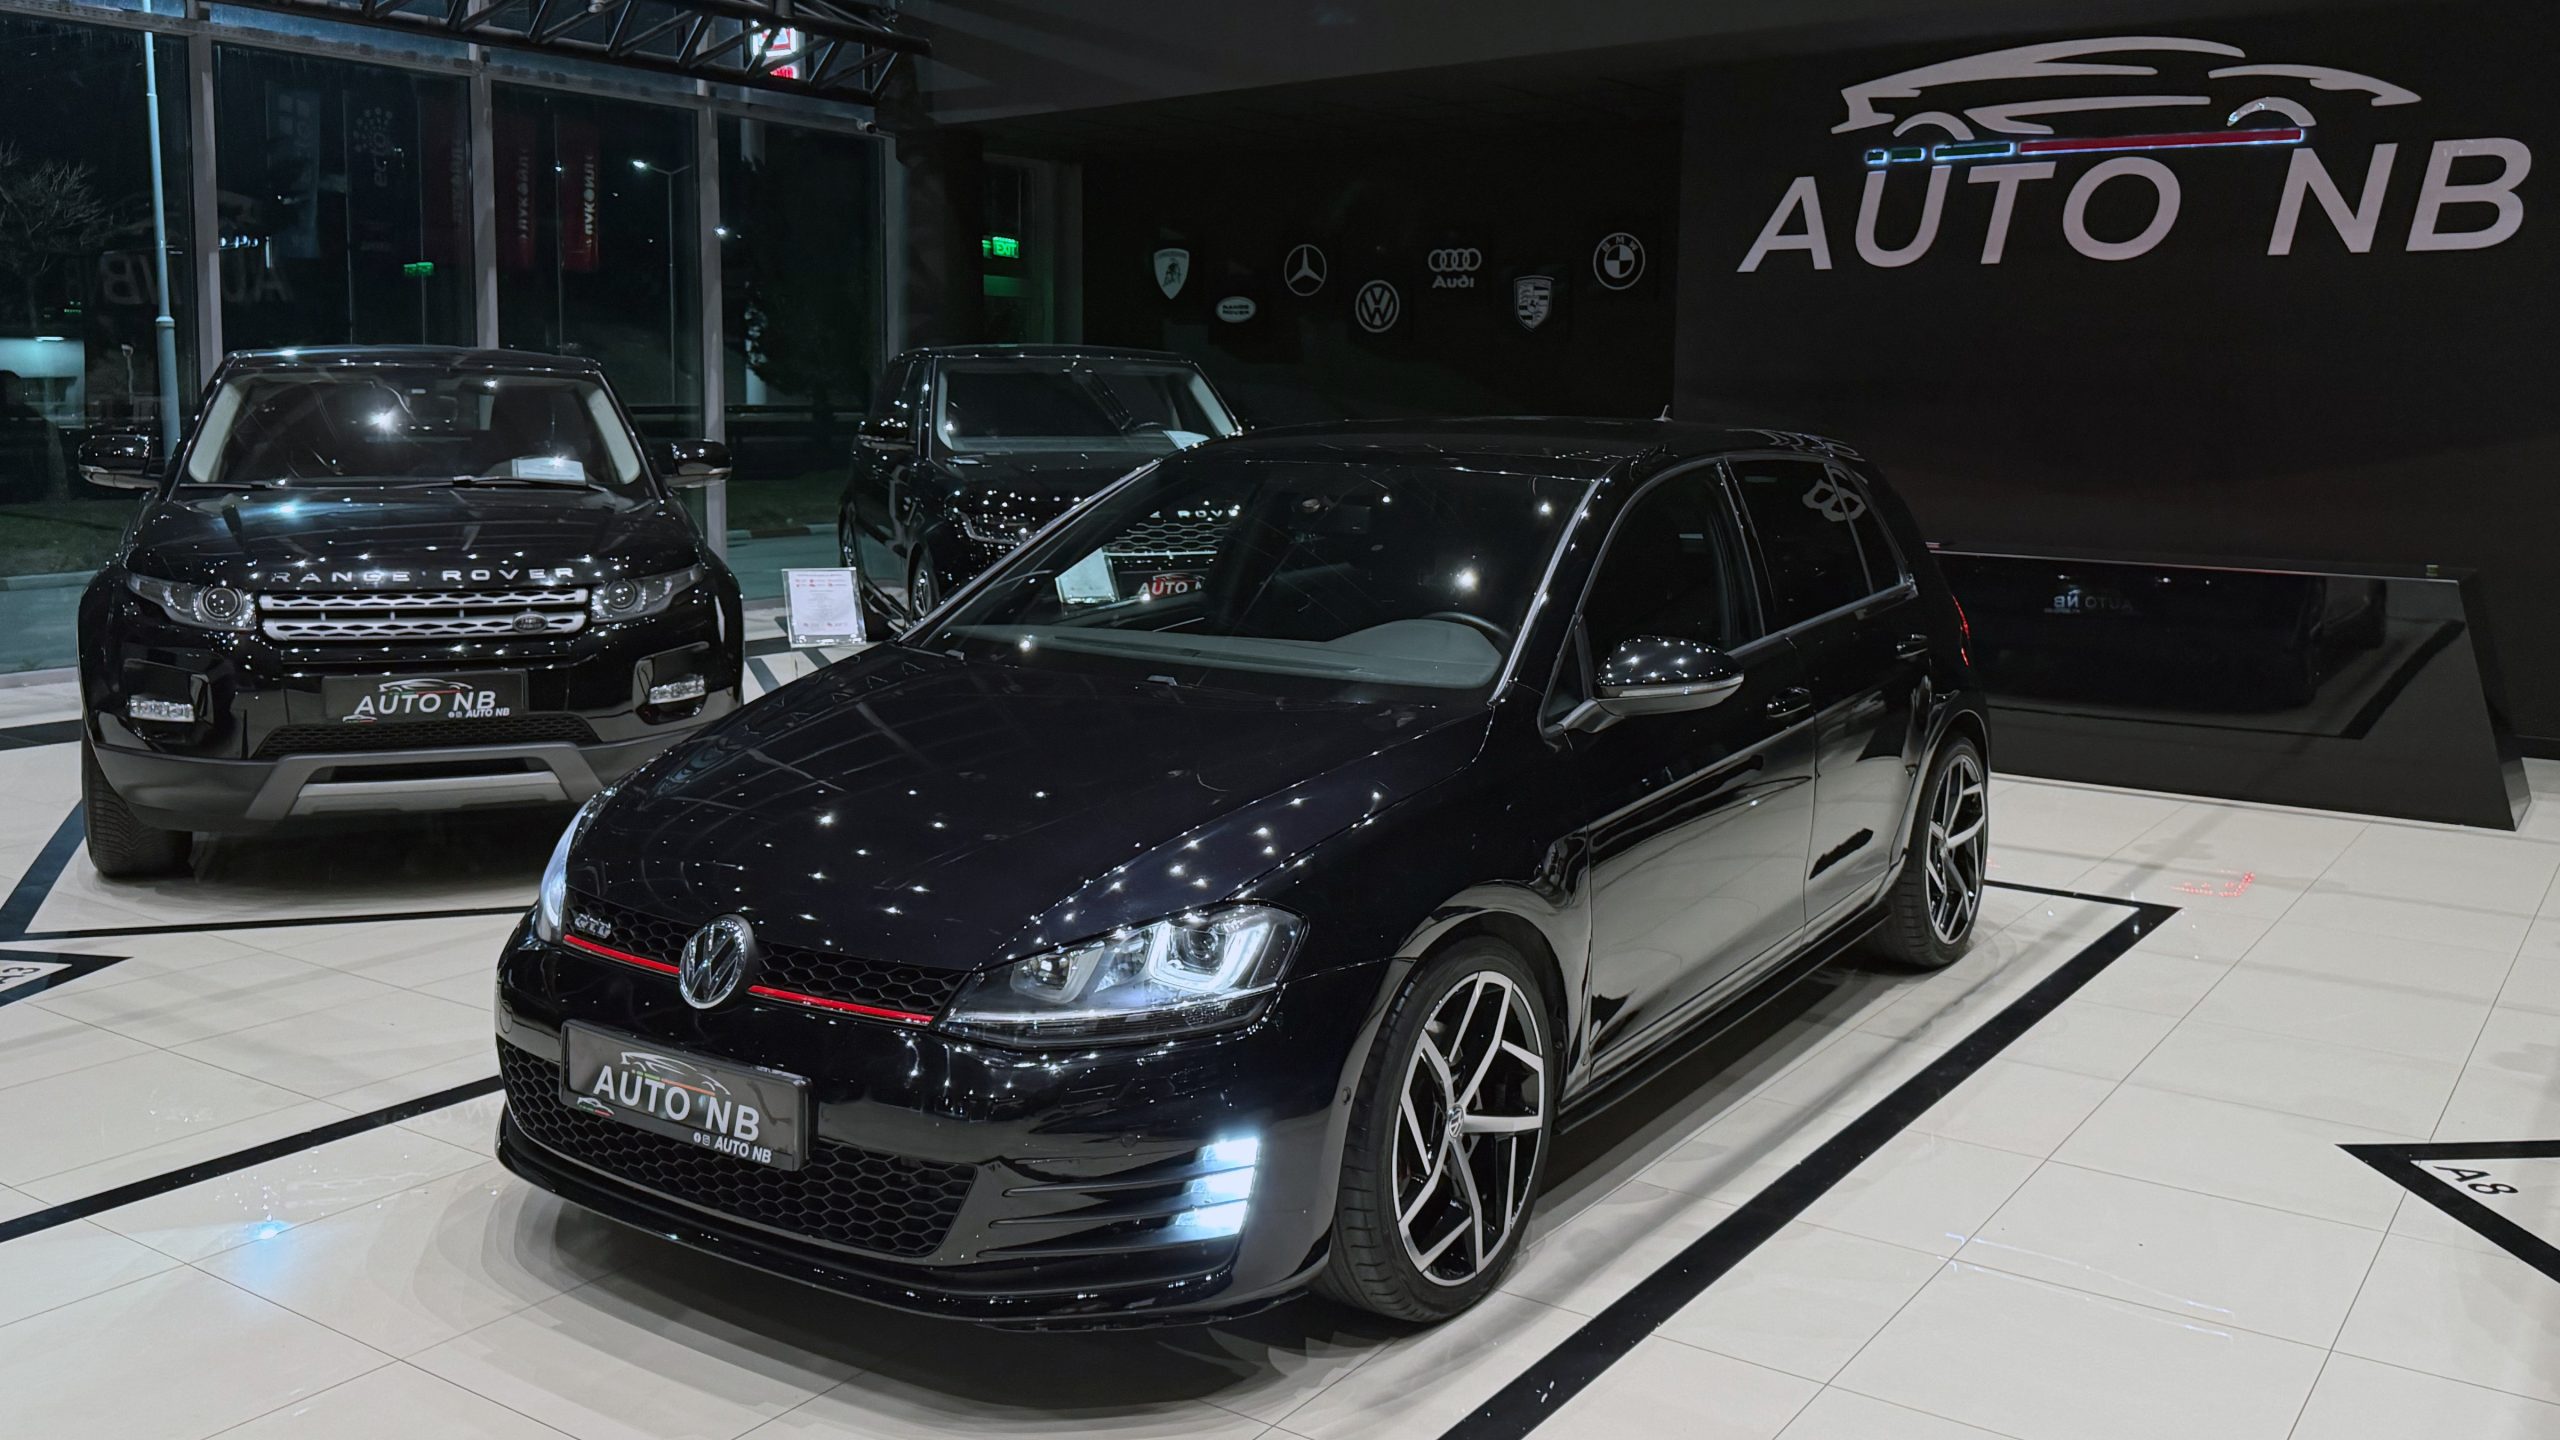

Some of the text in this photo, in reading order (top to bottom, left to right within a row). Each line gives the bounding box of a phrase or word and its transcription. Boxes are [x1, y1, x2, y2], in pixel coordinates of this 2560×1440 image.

[1737, 137, 2533, 273] AUTO NB
[995, 242, 1016, 257] EXIT
[1431, 274, 1475, 288] Audi
[271, 568, 575, 584] RANGE ROVER
[354, 691, 496, 715] AUTO NB
[466, 707, 510, 719] AUTO NB
[593, 1065, 760, 1142] AUTO NB
[715, 1136, 772, 1164] AUTO NB
